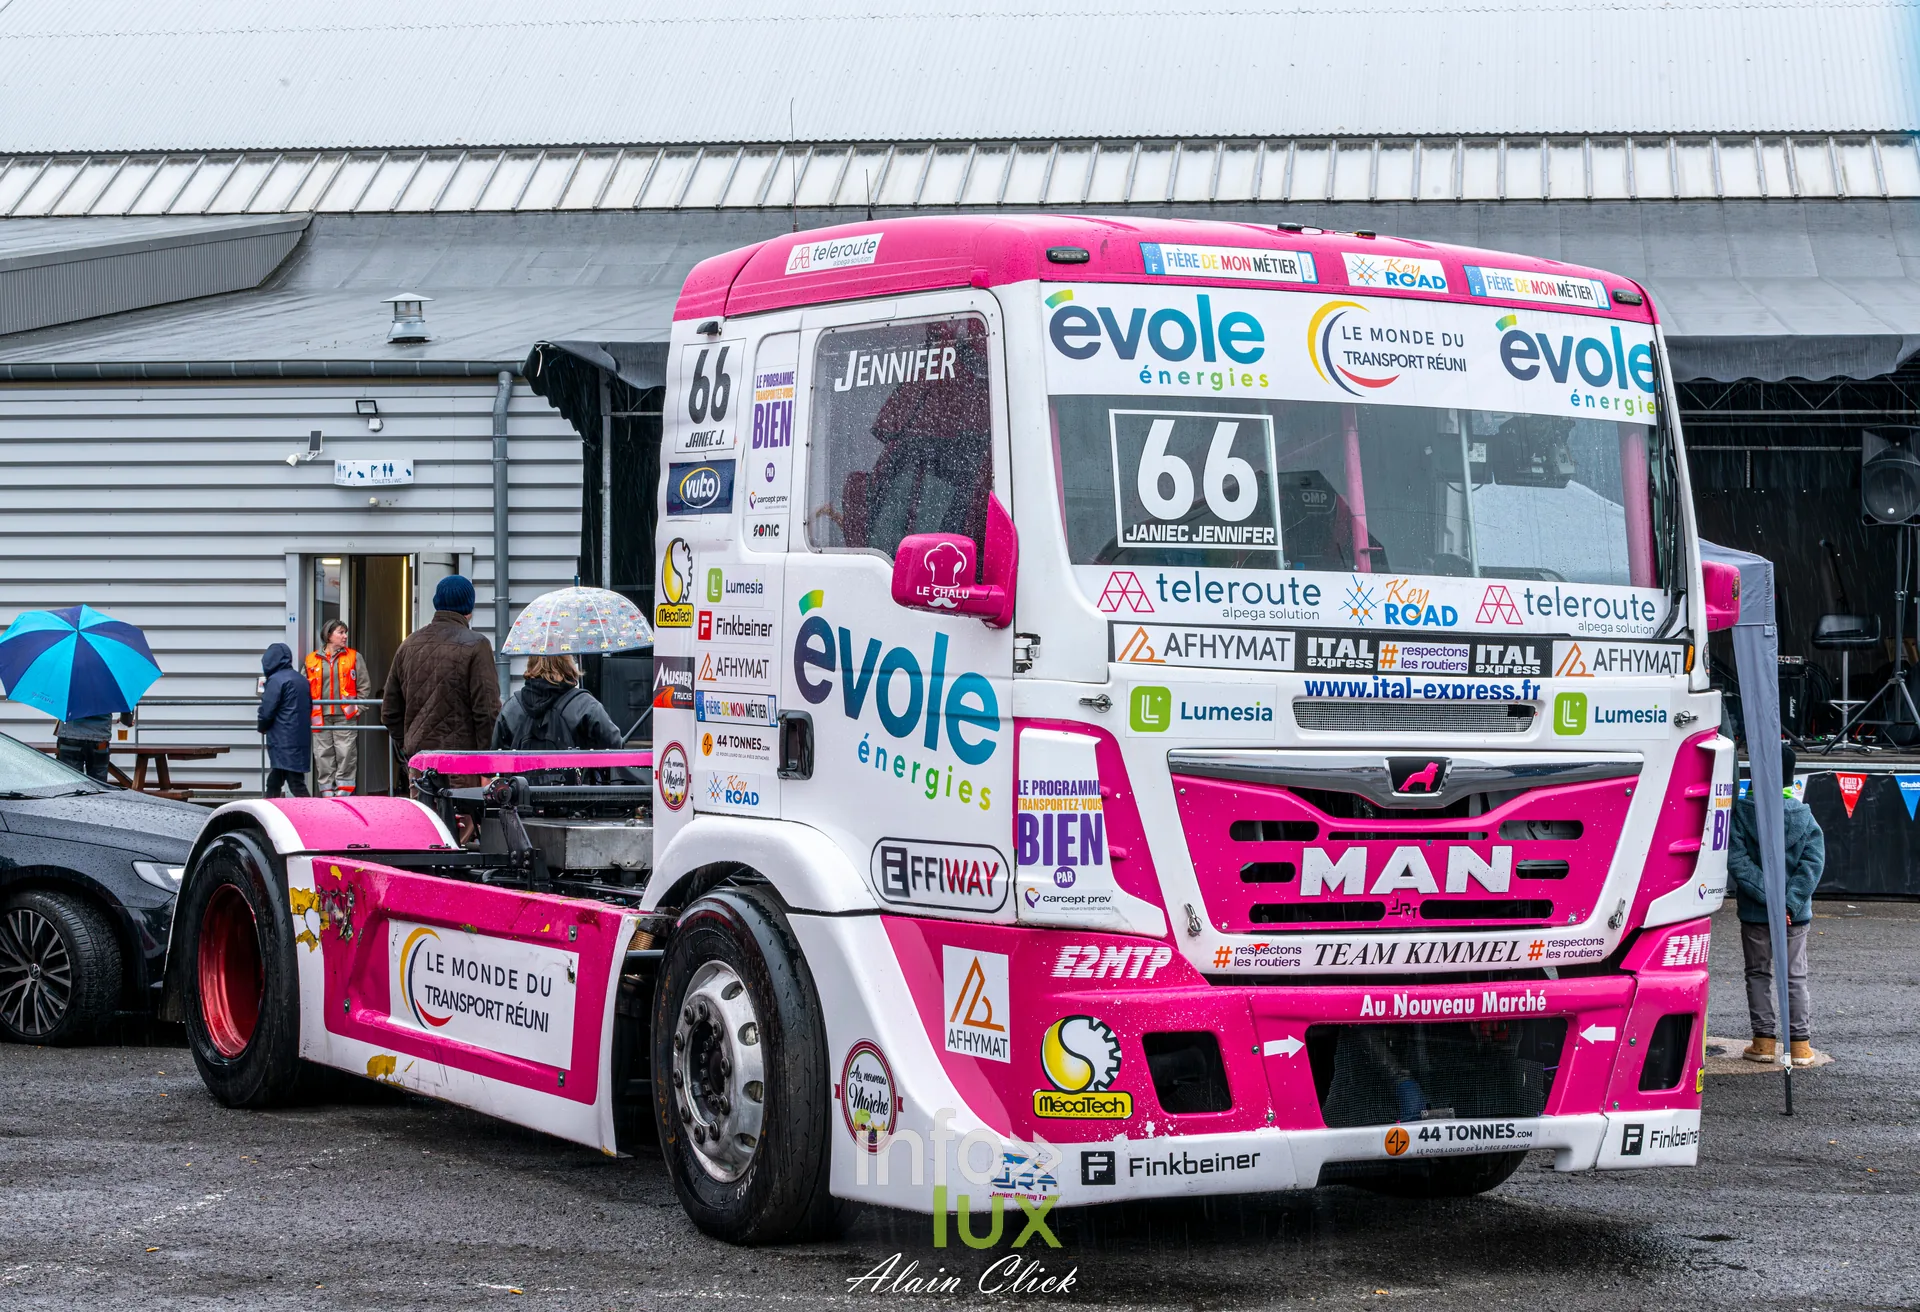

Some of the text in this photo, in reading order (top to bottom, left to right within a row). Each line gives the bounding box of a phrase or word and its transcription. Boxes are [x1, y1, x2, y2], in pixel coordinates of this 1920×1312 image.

[813, 238, 876, 261] teleroute
[1166, 249, 1200, 269] FIÈRE
[1202, 253, 1218, 269] DE
[1221, 254, 1251, 271] MON
[1253, 252, 1297, 274] MÉTIER
[1384, 258, 1421, 283] Key
[1385, 271, 1446, 290] ROAD
[1486, 272, 1514, 292] FIÈRE
[1514, 278, 1530, 294] DE
[1531, 280, 1557, 296] MON
[1557, 280, 1593, 300] MÉTIER
[1045, 289, 1265, 364] évole
[1342, 325, 1464, 347] LE MONDE DU
[1343, 350, 1467, 372] TRANSPORT RÉUNI
[1495, 314, 1655, 393] évole
[834, 347, 956, 392] JENNIFER
[1139, 365, 1269, 391] énergies
[688, 346, 731, 424] 66
[756, 375, 762, 389] LE
[1571, 389, 1661, 416] énergie
[752, 400, 792, 449] BIEN
[1138, 419, 1258, 521] 66
[1301, 491, 1328, 503] OMP
[1126, 524, 1275, 544] JANIEC JENNIFER
[725, 579, 763, 594] Lumesia
[916, 586, 970, 599] LE CHALU
[1156, 571, 1655, 621] teleroute Key teleroute
[1222, 607, 1320, 621] alpega solution
[1384, 603, 1458, 627] ROAD
[716, 615, 772, 637] Finkbeiner
[1578, 621, 1655, 635] alpega solution
[1164, 632, 1291, 661] AFHYMAT
[1307, 637, 1374, 659] ITAL
[1401, 646, 1469, 658] respectons
[1476, 644, 1541, 665] ITAL
[716, 657, 769, 679] AFHYMAT
[1307, 658, 1374, 669] express
[1401, 659, 1468, 671] les routiers
[1475, 664, 1541, 675] express
[1593, 648, 1681, 675] AFHYMAT
[653, 662, 692, 691] MUSHER
[794, 589, 1000, 765] évole
[1304, 676, 1541, 700] www.ital-express.fr
[705, 696, 721, 715] FIÈRE
[721, 701, 730, 716] DE
[730, 702, 745, 717] MON
[745, 699, 768, 719] MÉTIER
[1180, 702, 1273, 721] Lumesia
[1594, 705, 1667, 723] Lumesia
[717, 734, 727, 747] 44
[857, 732, 991, 811] énergies
[726, 775, 747, 796] Key
[1018, 780, 1029, 795] LE
[1715, 784, 1722, 796] LE
[725, 790, 759, 805] ROAD
[1018, 798, 1102, 811] TRANSPORTEZ-VOUS
[1018, 813, 1103, 866] BIEN
[1712, 810, 1731, 851] BI
[1056, 872, 1074, 883] PAR
[1301, 846, 1513, 896] MAN
[1042, 895, 1111, 904] carcept prev
[1235, 945, 1302, 957] respectons
[1314, 940, 1522, 966] TEAM KIMMEL
[1545, 947, 1603, 959] les routiers
[1546, 937, 1604, 950] respectons
[1050, 945, 1172, 979] E2MTP
[1233, 955, 1301, 968] les routiers
[426, 951, 552, 997] LE MONDE DU
[425, 984, 549, 1033] TRANSPORT RÉUNI
[1360, 989, 1546, 1017] Au Nouveau Marché
[948, 1028, 1008, 1058] AFHYMAT
[1039, 1095, 1125, 1113] MécaTech
[1418, 1126, 1441, 1142] 44
[1650, 1124, 1699, 1149] Finkbeine
[1129, 1151, 1261, 1177] Finkbeiner
